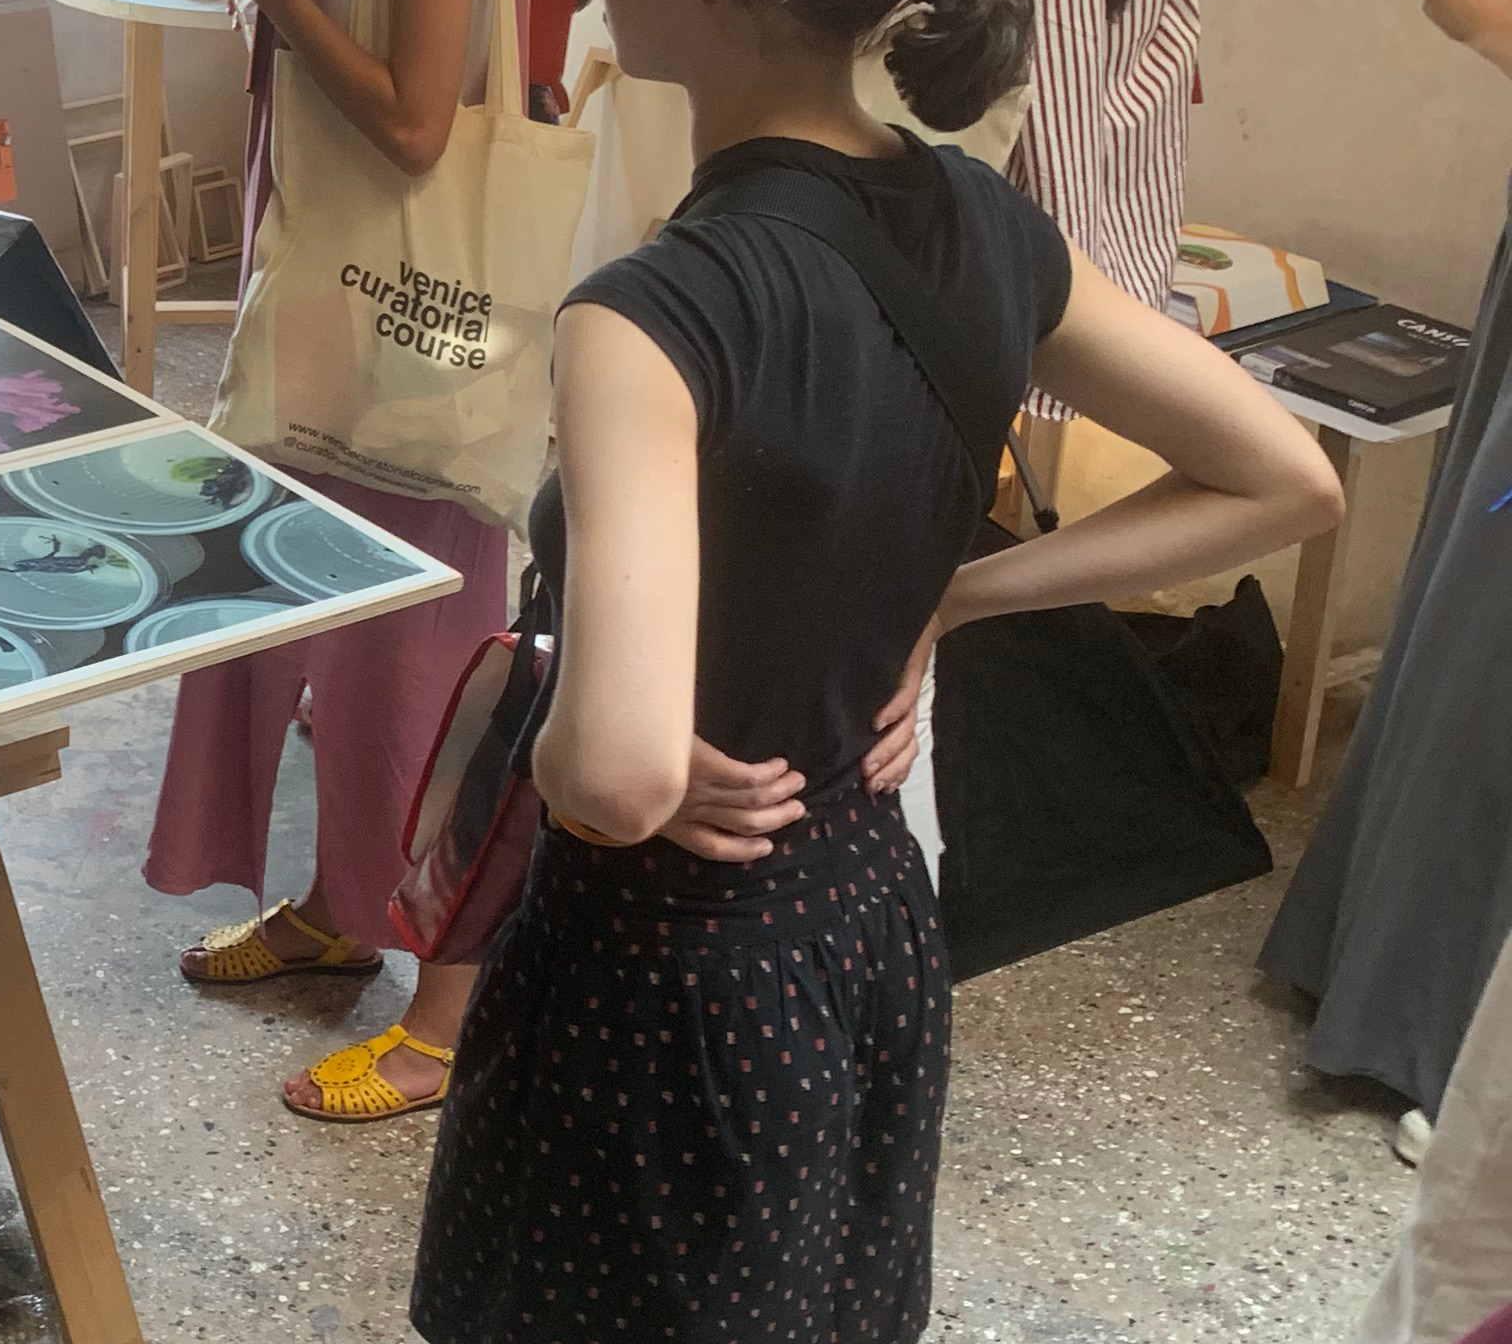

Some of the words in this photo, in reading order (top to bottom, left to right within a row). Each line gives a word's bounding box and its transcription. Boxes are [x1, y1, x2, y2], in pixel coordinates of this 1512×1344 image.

[340, 264, 491, 344] curatorial
[399, 261, 493, 316] venice
[376, 313, 487, 370] course
[1396, 318, 1471, 347] CANSO
